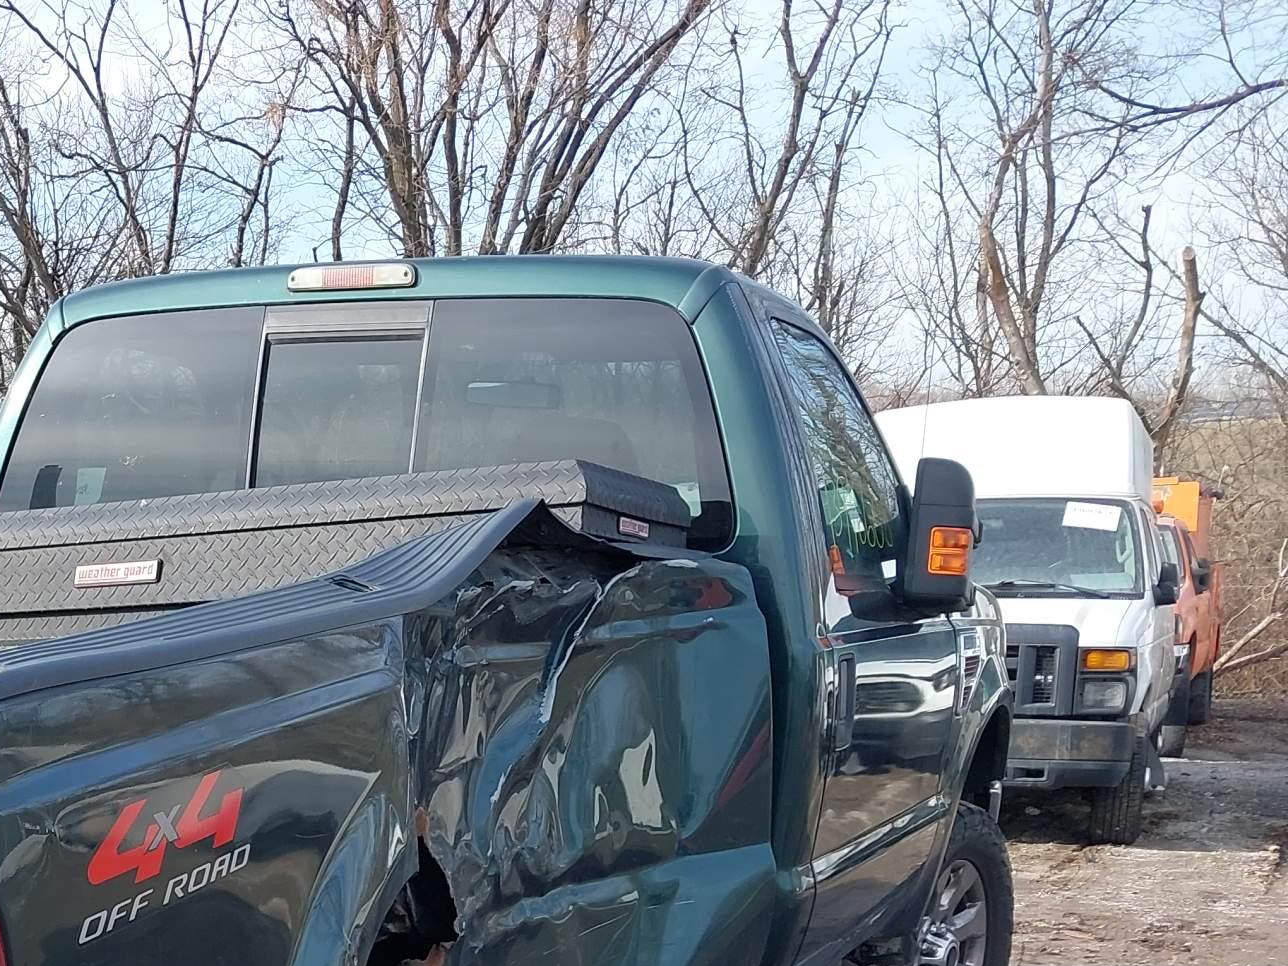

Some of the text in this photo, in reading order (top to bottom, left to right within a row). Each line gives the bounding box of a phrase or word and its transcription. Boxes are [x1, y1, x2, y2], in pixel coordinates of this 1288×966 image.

[78, 562, 154, 579] weather guard
[78, 843, 251, 945] OFF ROAD
